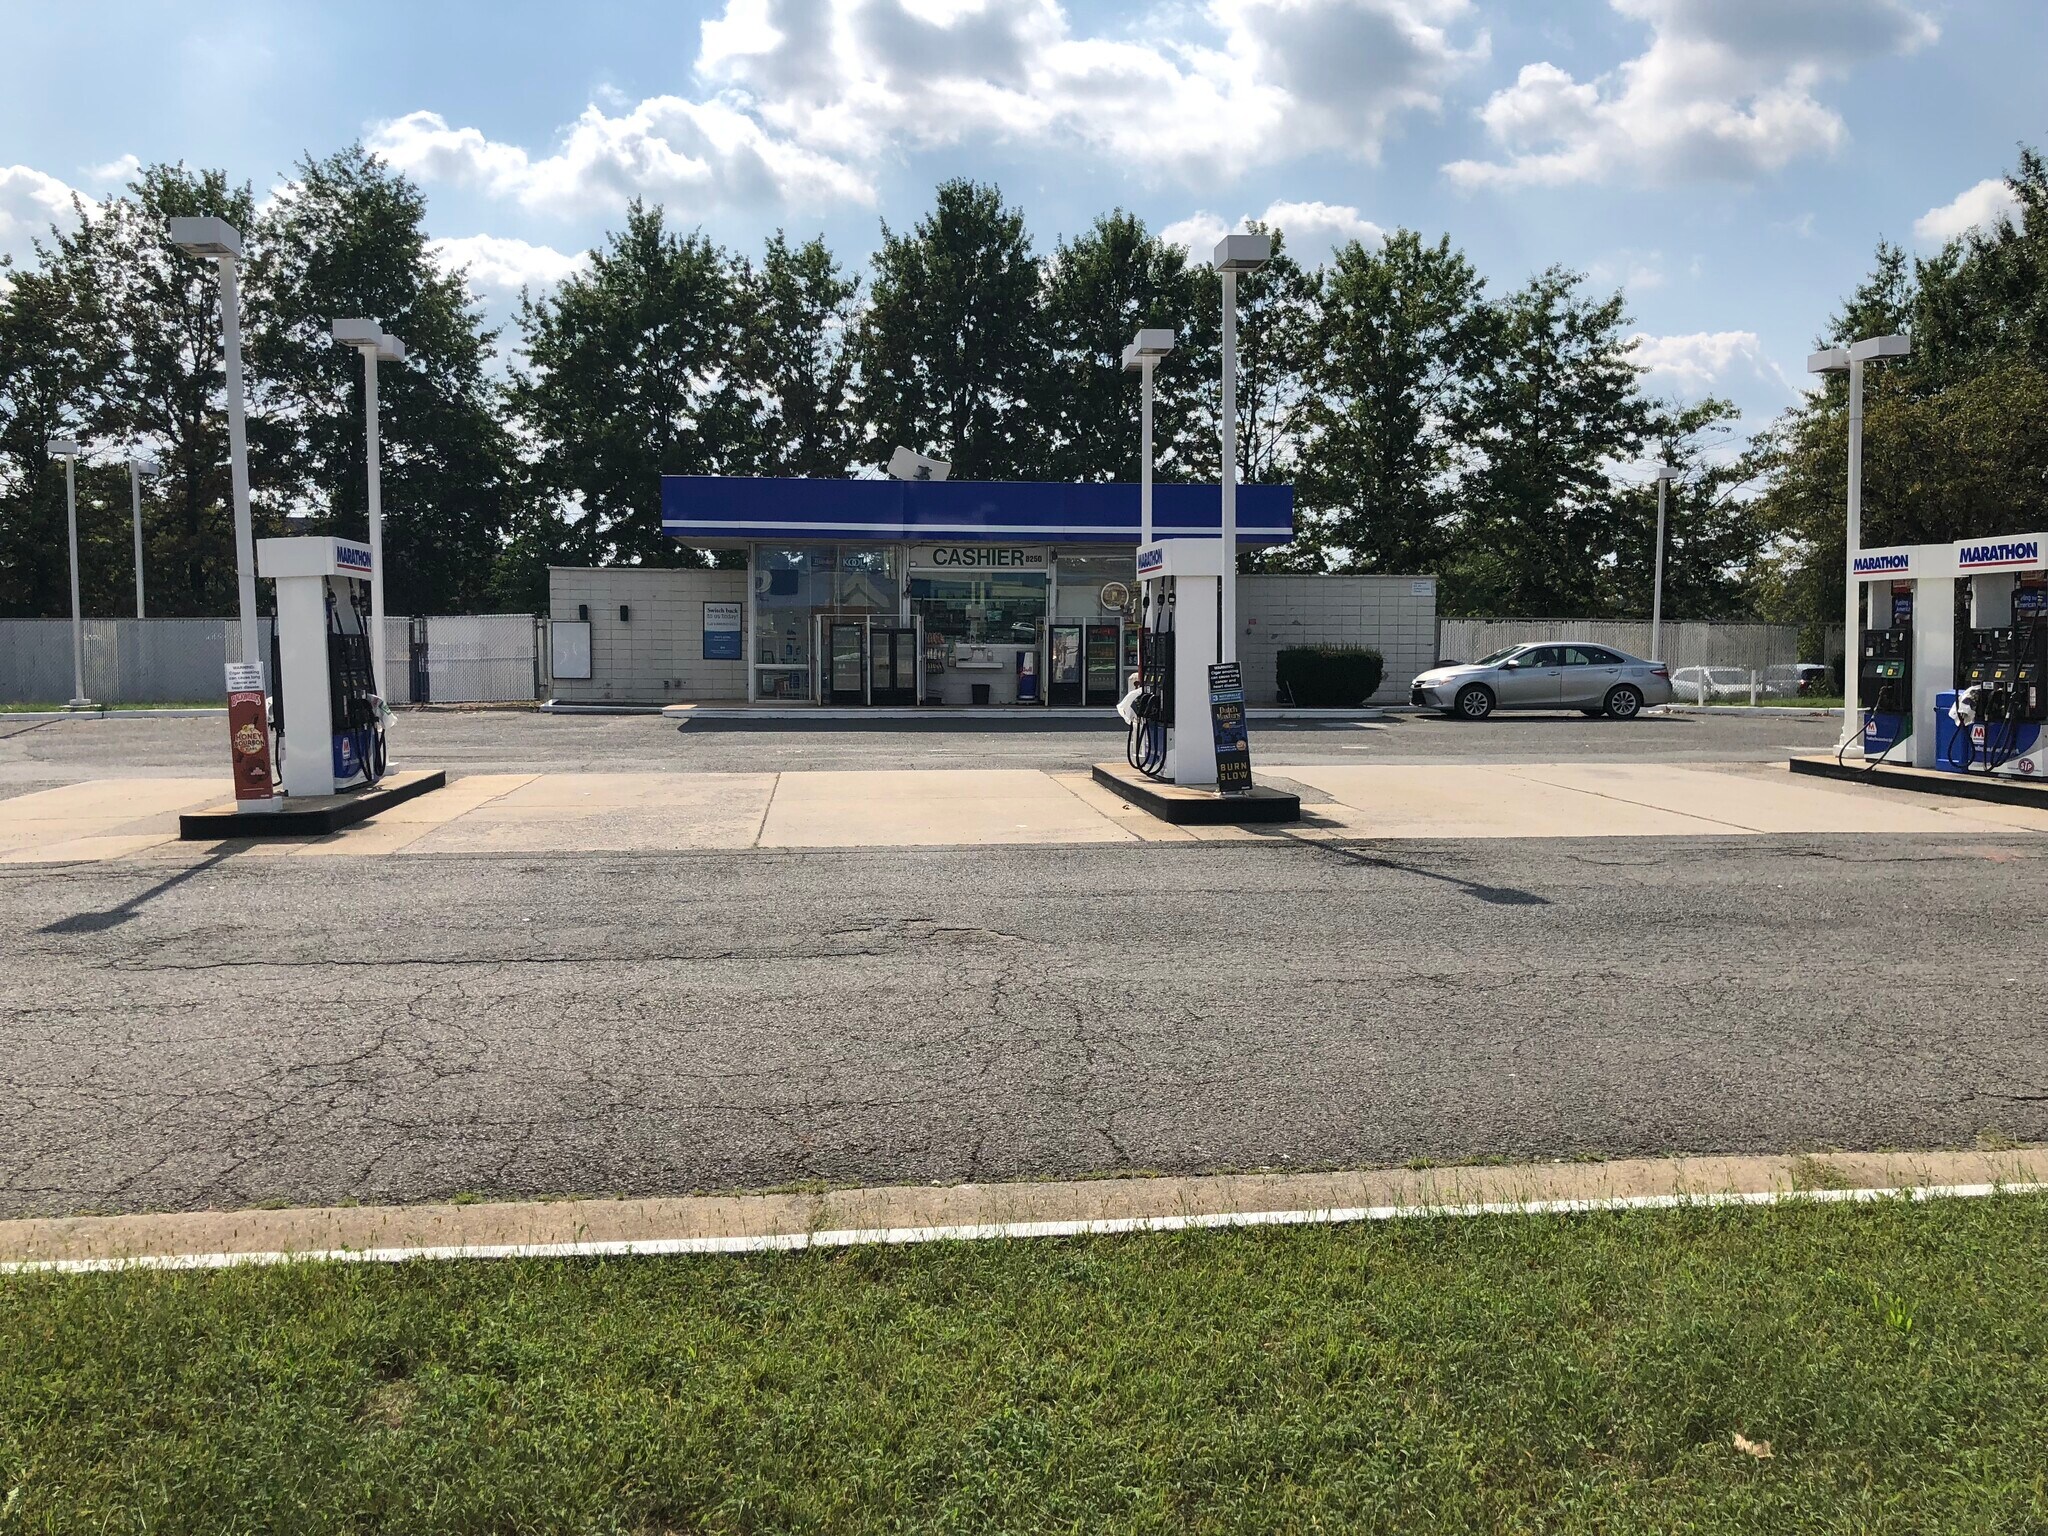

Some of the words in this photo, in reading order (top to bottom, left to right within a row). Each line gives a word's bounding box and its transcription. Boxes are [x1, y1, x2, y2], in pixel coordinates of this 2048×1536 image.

[337, 546, 372, 567] MARATHON
[933, 548, 1024, 566] CASHIER
[1026, 555, 1043, 563] 8250
[1959, 542, 2038, 563] MARATHON
[842, 558, 866, 567] KOOL
[1138, 548, 1162, 569] MARATHON
[1853, 554, 1909, 571] MARATHON
[2007, 631, 2013, 640] 2
[1219, 705, 1238, 713] Dutch
[1216, 712, 1240, 720] Masters
[233, 732, 262, 741] HONEY
[1973, 727, 1984, 737] M
[1220, 761, 1247, 771] BURN
[2020, 760, 2033, 771] STP
[1220, 771, 1248, 781] SLOW
